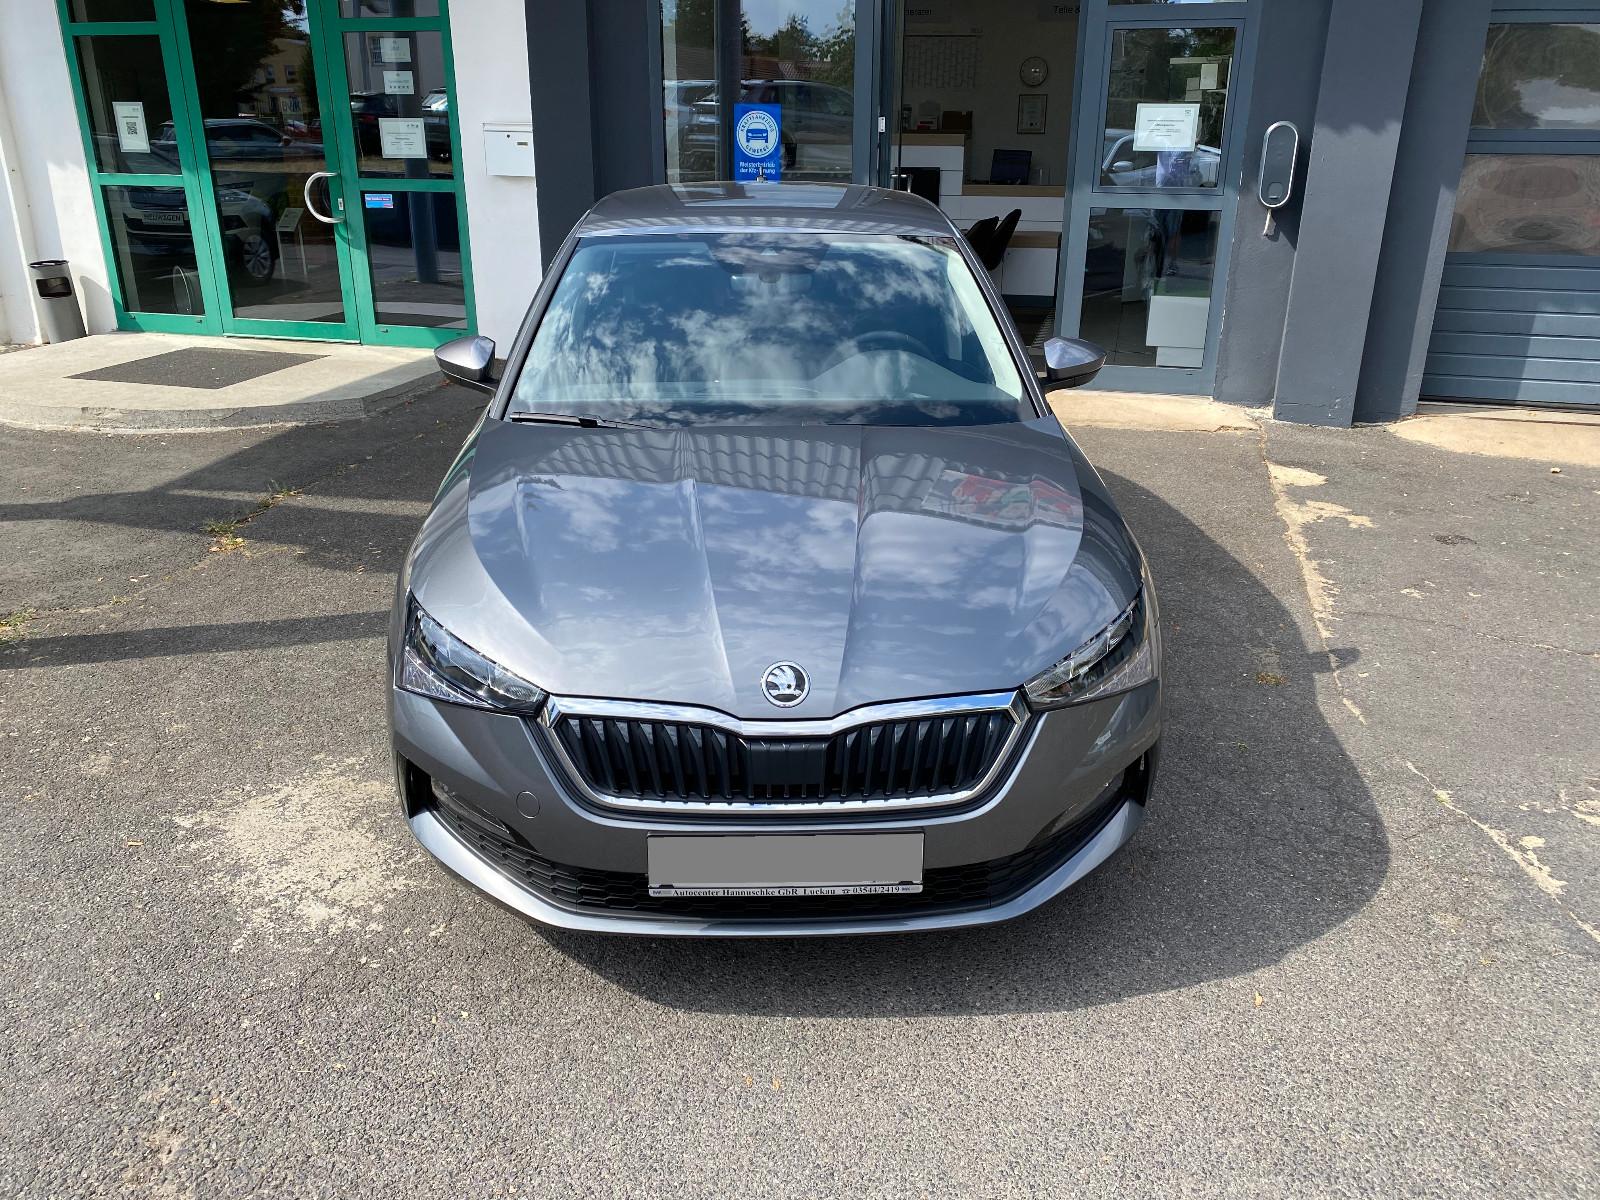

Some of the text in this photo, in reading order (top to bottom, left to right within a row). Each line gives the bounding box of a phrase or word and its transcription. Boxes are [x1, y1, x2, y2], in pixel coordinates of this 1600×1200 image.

[745, 144, 769, 154] GEWERBE
[672, 888, 720, 897] Autocenter
[722, 888, 776, 897] Hannuschke
[777, 887, 798, 896] GbR
[803, 887, 836, 895] Luckau
[852, 885, 900, 894] 03544/2419
